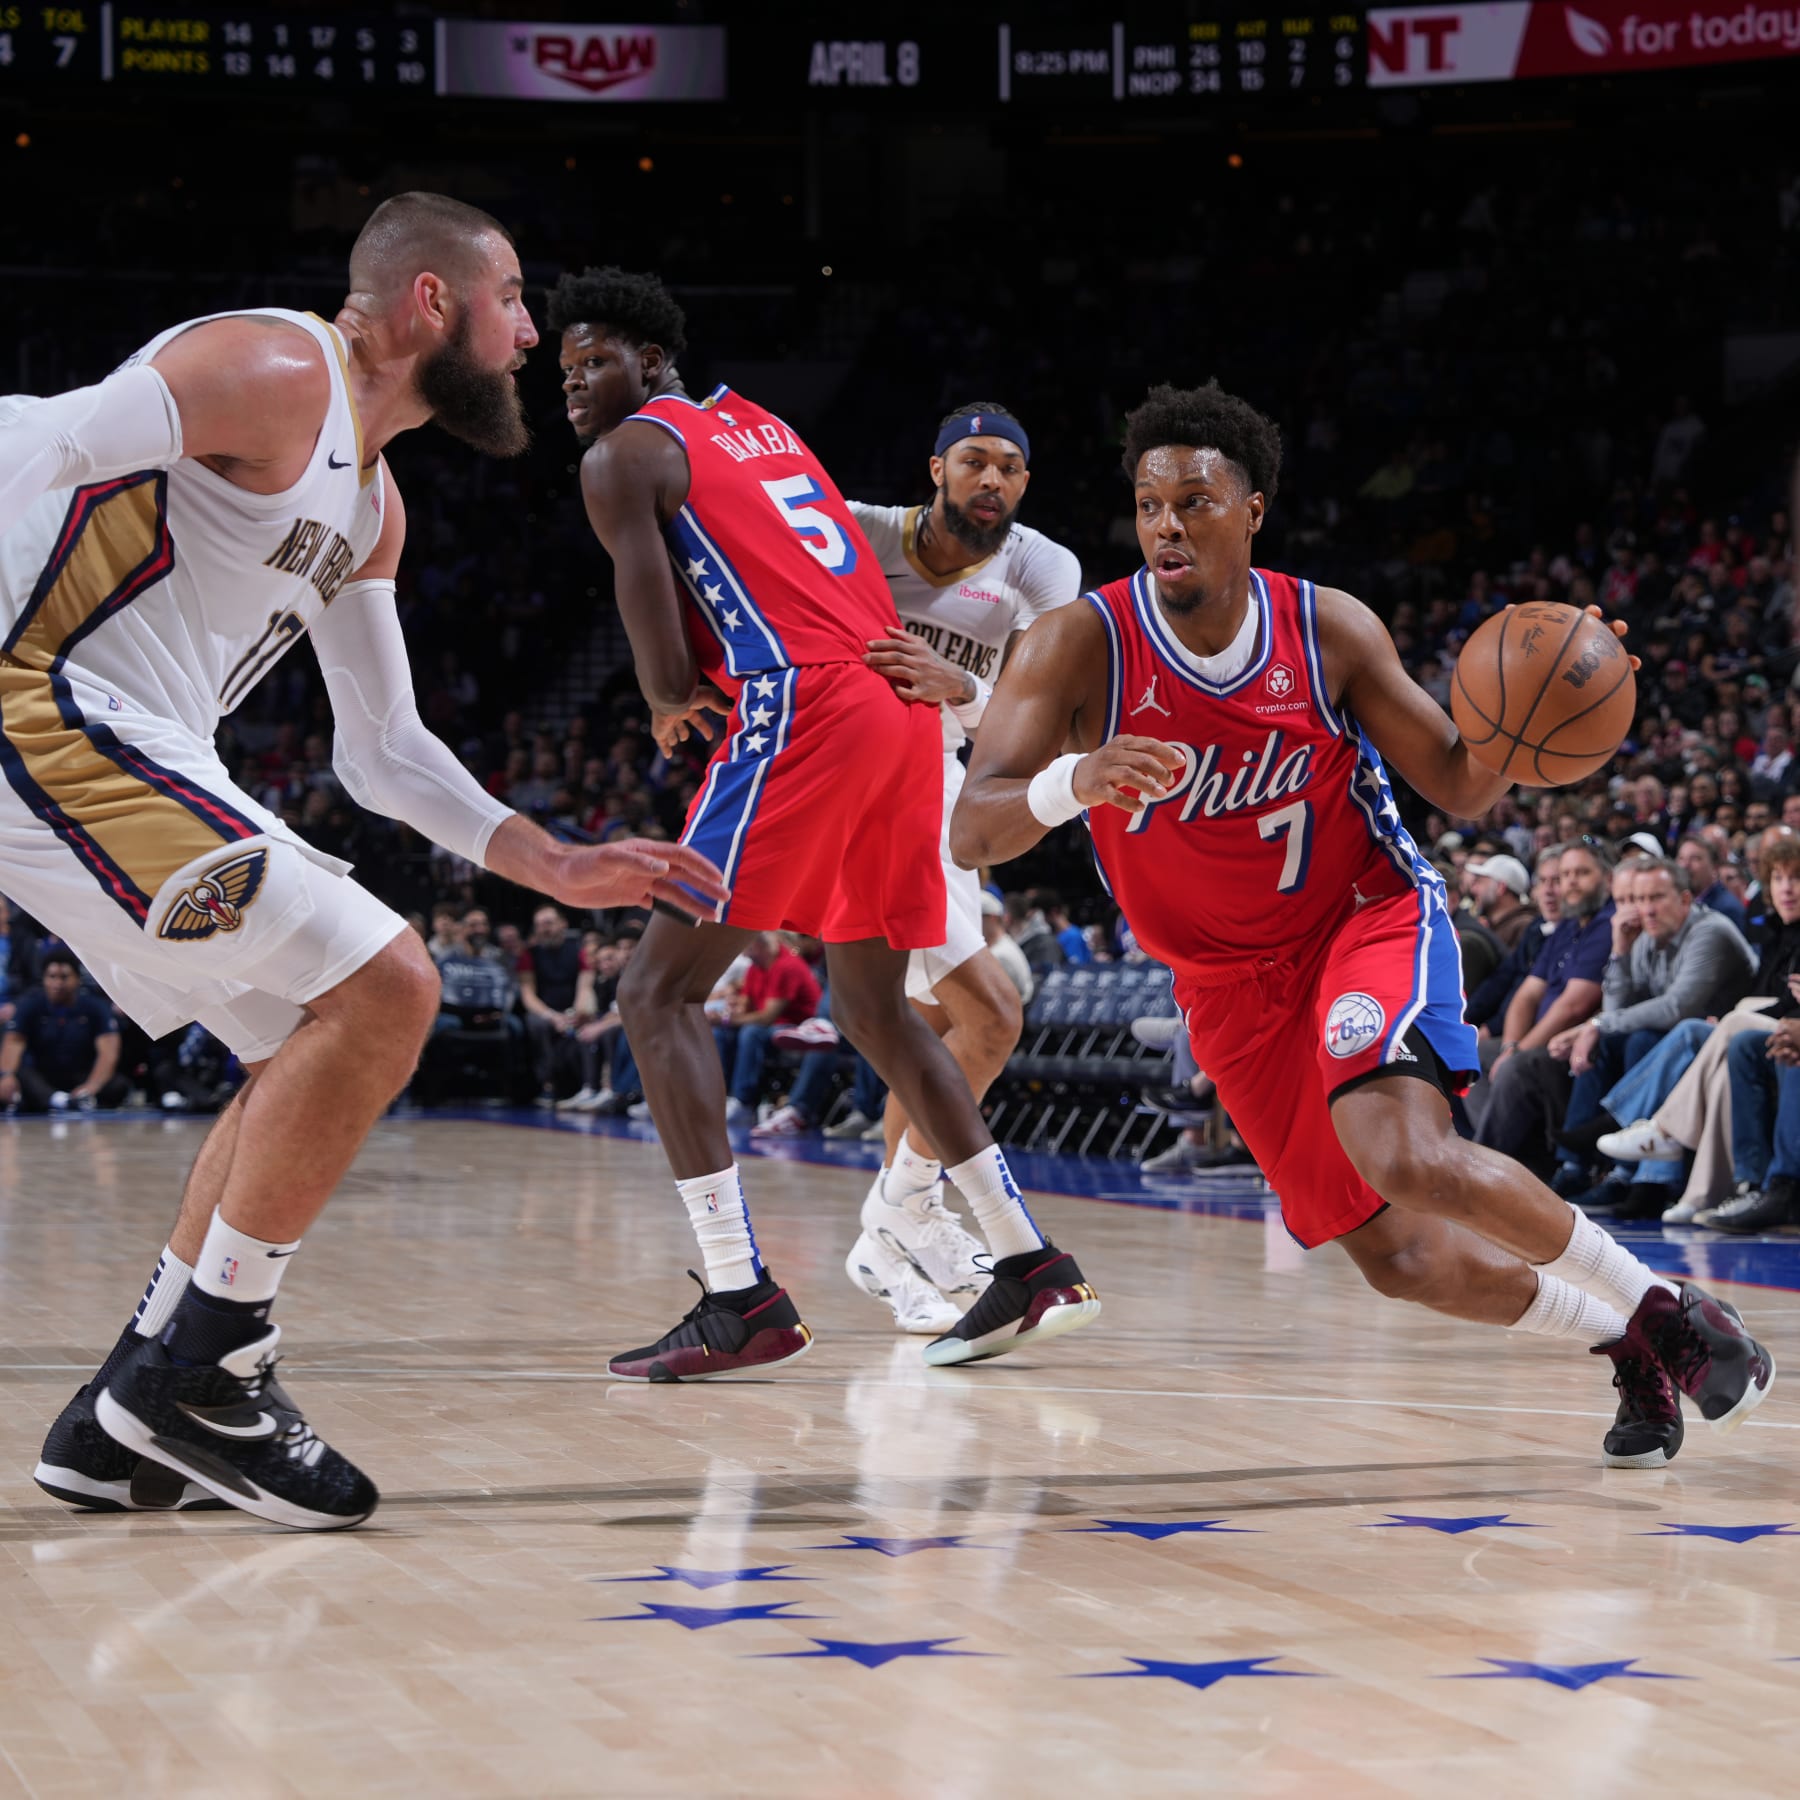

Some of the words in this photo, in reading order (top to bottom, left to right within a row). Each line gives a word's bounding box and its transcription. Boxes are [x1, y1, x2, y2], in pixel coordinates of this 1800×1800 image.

[121, 18, 209, 43] PLAYER
[274, 24, 288, 46] 1
[309, 26, 336, 48] 17
[357, 28, 375, 51] 5
[1621, 15, 1680, 54] for
[1689, 3, 1800, 49] today
[53, 37, 76, 66] 7
[122, 48, 209, 73] POINTS
[314, 57, 333, 79] 4
[361, 59, 375, 82] 1
[535, 35, 657, 80] RAW
[808, 41, 891, 86] APRIL
[897, 41, 920, 86] 8
[1068, 50, 1109, 74] PM
[1134, 46, 1175, 68] PHI
[1289, 39, 1306, 62] 2
[1129, 71, 1181, 95] NOP
[710, 423, 804, 463] BAMBA
[760, 473, 858, 577] 5
[262, 518, 331, 578] NEW
[959, 584, 1000, 605] ibotta
[217, 604, 305, 711] 17
[1255, 701, 1309, 715] crypto.com
[1125, 730, 1316, 834] Phila
[1256, 800, 1315, 895] 7
[1330, 1018, 1377, 1047] 76ers
